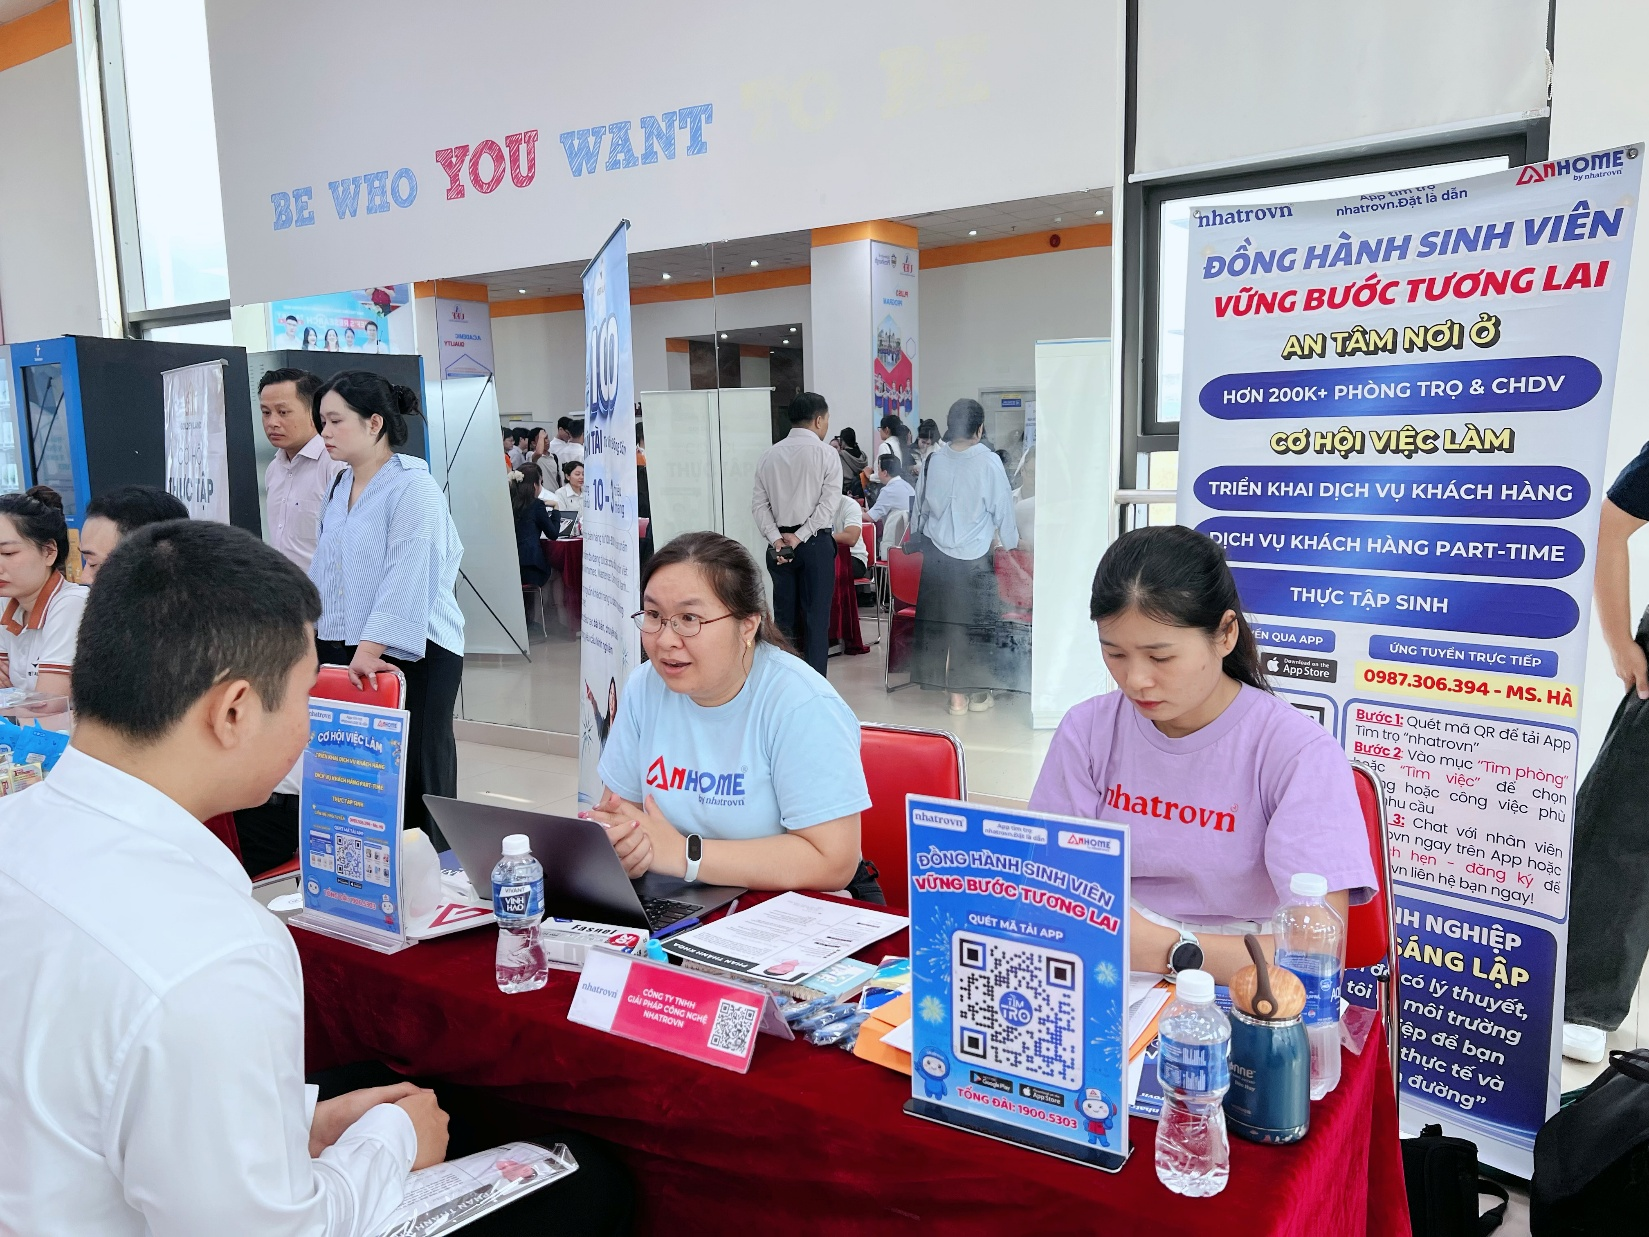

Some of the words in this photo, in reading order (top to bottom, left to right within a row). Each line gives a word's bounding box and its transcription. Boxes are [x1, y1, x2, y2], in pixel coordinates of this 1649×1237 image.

[270, 186, 315, 231] BE
[328, 167, 418, 220] WHO
[435, 129, 539, 200] YOU
[559, 103, 714, 178] WANT
[1584, 169, 1623, 180] nhatrovn
[1425, 192, 1438, 204] là
[1197, 204, 1293, 228] nhatrovn
[1203, 239, 1297, 279] ĐỒNG
[1303, 230, 1411, 271] HÀNH
[1417, 221, 1516, 260] SINH
[1523, 200, 1624, 244] VIÊN
[1214, 286, 1297, 318] VỮNG
[1303, 271, 1396, 312] BƯỚC
[1406, 266, 1534, 305] TƯƠNG
[1542, 260, 1610, 292] LAI
[1282, 332, 1325, 359] AN
[1332, 324, 1394, 356] TÂM
[1403, 322, 1461, 352] NƠI
[1470, 313, 1501, 348] Ở
[1223, 383, 1264, 404] HƠN
[1269, 385, 1328, 403] 200K+
[1334, 380, 1411, 401] PHÒNG
[1417, 379, 1463, 402] TRỌ
[1470, 379, 1485, 395] &
[1491, 375, 1566, 394] CHDV
[591, 425, 603, 454] TÀI
[1270, 429, 1310, 453] CƠ
[1314, 427, 1363, 455] HỘI
[1370, 426, 1437, 455] VIỆC
[1443, 423, 1515, 452] LÀM
[593, 478, 604, 511] 10
[1209, 476, 1264, 497] TRIỂN
[1267, 481, 1314, 498] KHAI
[1319, 482, 1370, 502] DỊCH
[1375, 483, 1406, 503] VỤ
[1411, 480, 1494, 501] KHÁCH
[1500, 478, 1573, 502] HÀNG
[1209, 531, 1254, 551] DỊCH
[1258, 532, 1285, 552] VỤ
[1290, 532, 1362, 553] KHÁCH
[1367, 533, 1429, 556] HÀNG
[1435, 539, 1566, 562] PART-TIME
[1290, 586, 1344, 606] THỰC
[1349, 588, 1390, 611] TẬP
[1396, 594, 1448, 613] SINH
[1271, 632, 1297, 643] QUA
[1299, 635, 1323, 645] APP
[1389, 642, 1418, 656] ỨNG
[1420, 646, 1465, 661] TUYỂN
[1468, 651, 1506, 666] TRỰC
[1510, 654, 1542, 668] TIẾP
[1283, 664, 1303, 677] App
[1303, 667, 1330, 678] Store
[1363, 668, 1490, 696] 0987.306.394
[1506, 684, 1542, 703] MS.
[1547, 687, 1573, 708] HÀ
[364, 737, 383, 753] LÀM
[1355, 725, 1380, 739] Tìm
[1382, 729, 1400, 742] trọ
[1356, 708, 1394, 726] Bước
[1407, 715, 1442, 731] Quét
[1444, 721, 1471, 735] mã
[1474, 724, 1496, 739] QR
[1498, 726, 1519, 742] để
[1522, 731, 1540, 744] tải
[1543, 734, 1571, 752] App
[1354, 741, 1391, 757] Bước
[1407, 749, 1436, 764] Vào
[1439, 755, 1473, 771] mục
[706, 796, 745, 807] nhatrovn
[1405, 782, 1440, 798] hoặc
[1449, 791, 1487, 810] công
[1498, 799, 1528, 814] việc
[1538, 805, 1566, 823] phù
[1409, 798, 1435, 815] cầu
[1496, 780, 1516, 794] để
[1532, 787, 1567, 805] chọn
[914, 811, 964, 828] nhatrovn
[1107, 783, 1235, 833] nhatrovn
[1413, 818, 1448, 834] Chat
[1456, 825, 1477, 840] với
[1486, 831, 1526, 849] nhân
[1534, 840, 1563, 858] viên
[1414, 834, 1452, 853] ngay
[1456, 842, 1485, 858] trên
[1491, 849, 1522, 868] App
[1527, 856, 1562, 876] hoặc
[917, 845, 967, 869] ĐỒNG
[970, 848, 1022, 874] HÀNH
[1023, 863, 1068, 889] SINH
[1070, 873, 1115, 908] VIÊN
[1410, 850, 1437, 866] hẹn
[1466, 861, 1506, 883] đăng
[1517, 872, 1534, 888] ký
[1543, 877, 1561, 894] để
[1410, 866, 1435, 882] liên
[1438, 873, 1457, 887] hệ
[1459, 876, 1487, 895] bạn
[1491, 885, 1534, 905] ngay!
[914, 870, 965, 893] VỮNG
[966, 871, 1018, 899] BƯỚC
[1019, 885, 1088, 918] TƯƠNG
[1088, 907, 1121, 935] LAI
[968, 912, 997, 928] QUÉT
[1000, 918, 1020, 932] MÃ
[1023, 920, 1038, 936] TẢI
[1040, 926, 1064, 941] APP
[1425, 916, 1522, 954] NGHIỆP
[672, 941, 697, 954] KHOA
[725, 958, 749, 968] PHAN
[1471, 956, 1530, 990] LẬP
[581, 981, 619, 999] nhatrovn
[642, 988, 664, 1001] CÔNG
[665, 993, 674, 1004] TY
[675, 995, 696, 1009] TNHH
[1346, 980, 1373, 999] tôi
[1400, 973, 1425, 989] có
[1429, 978, 1449, 998] lý
[1452, 985, 1529, 1021] thuyết,
[627, 994, 642, 1006] GIẢI
[643, 997, 661, 1010] PHÁP
[662, 1001, 685, 1017] CÔNG
[686, 1008, 708, 1025] NGHỆ
[643, 1010, 685, 1029] NHATROVN
[1403, 998, 1445, 1021] môi
[1447, 1010, 1522, 1046] trường
[1431, 1028, 1459, 1050] để
[1462, 1040, 1505, 1065] bạn
[1400, 1046, 1447, 1071] thực
[1451, 1064, 1476, 1081] tế
[1478, 1073, 1505, 1092] và
[957, 1086, 990, 1104] TỔNG
[1018, 1104, 1078, 1129] 1900.5303
[1032, 1092, 1045, 1101] App
[1044, 1094, 1061, 1105] Store
